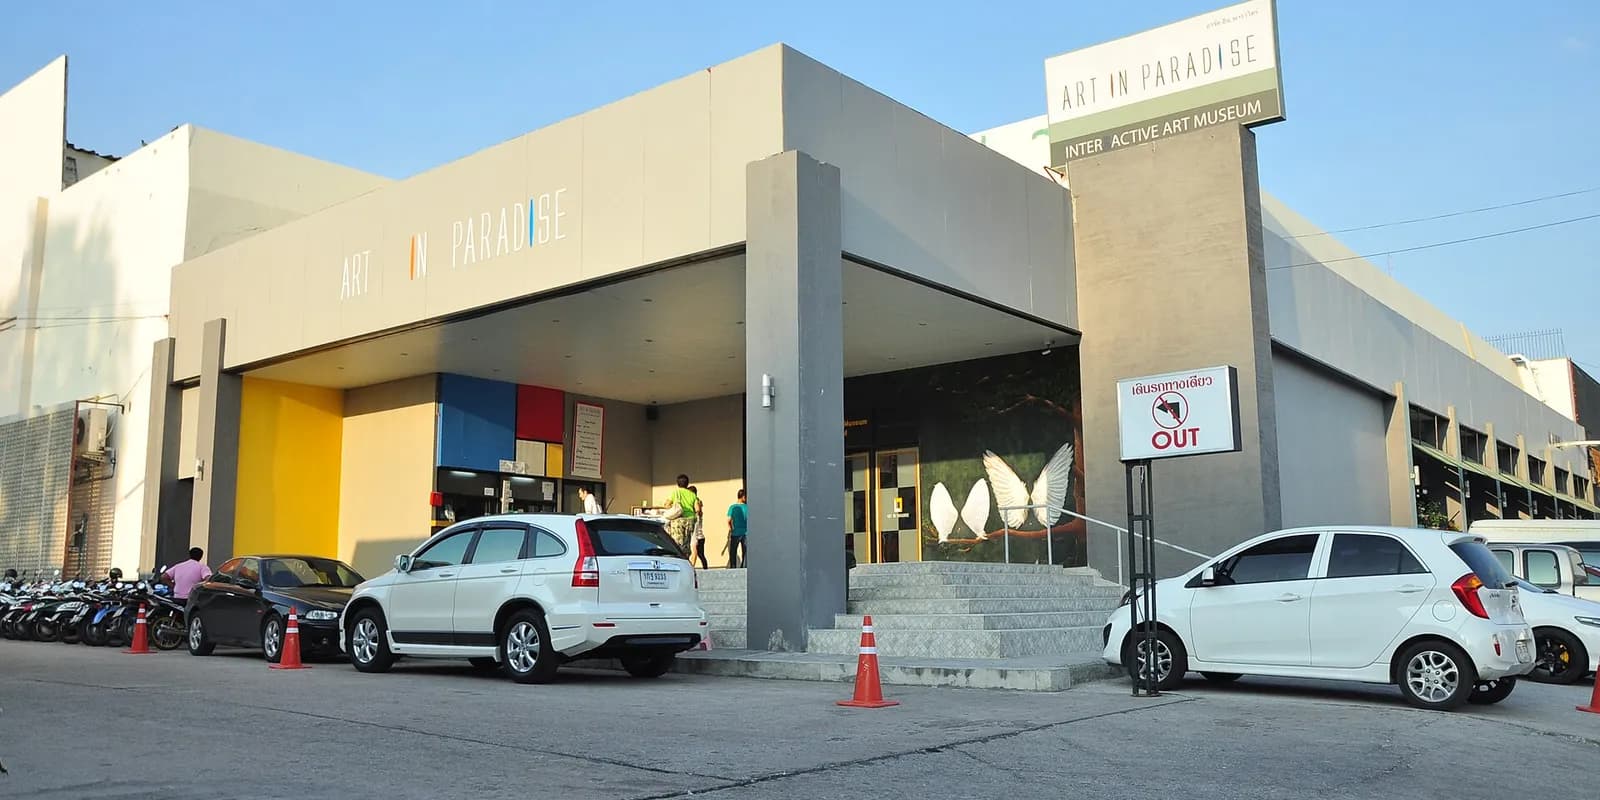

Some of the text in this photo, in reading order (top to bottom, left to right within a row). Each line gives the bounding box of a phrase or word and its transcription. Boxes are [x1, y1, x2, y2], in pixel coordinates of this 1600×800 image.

[1062, 34, 1257, 111] ART IN PARADISE
[1065, 99, 1262, 160] INTER ACTIVE ART MUSEUM
[340, 187, 568, 301] ART IN PARADISE
[1151, 427, 1200, 450] OUT
